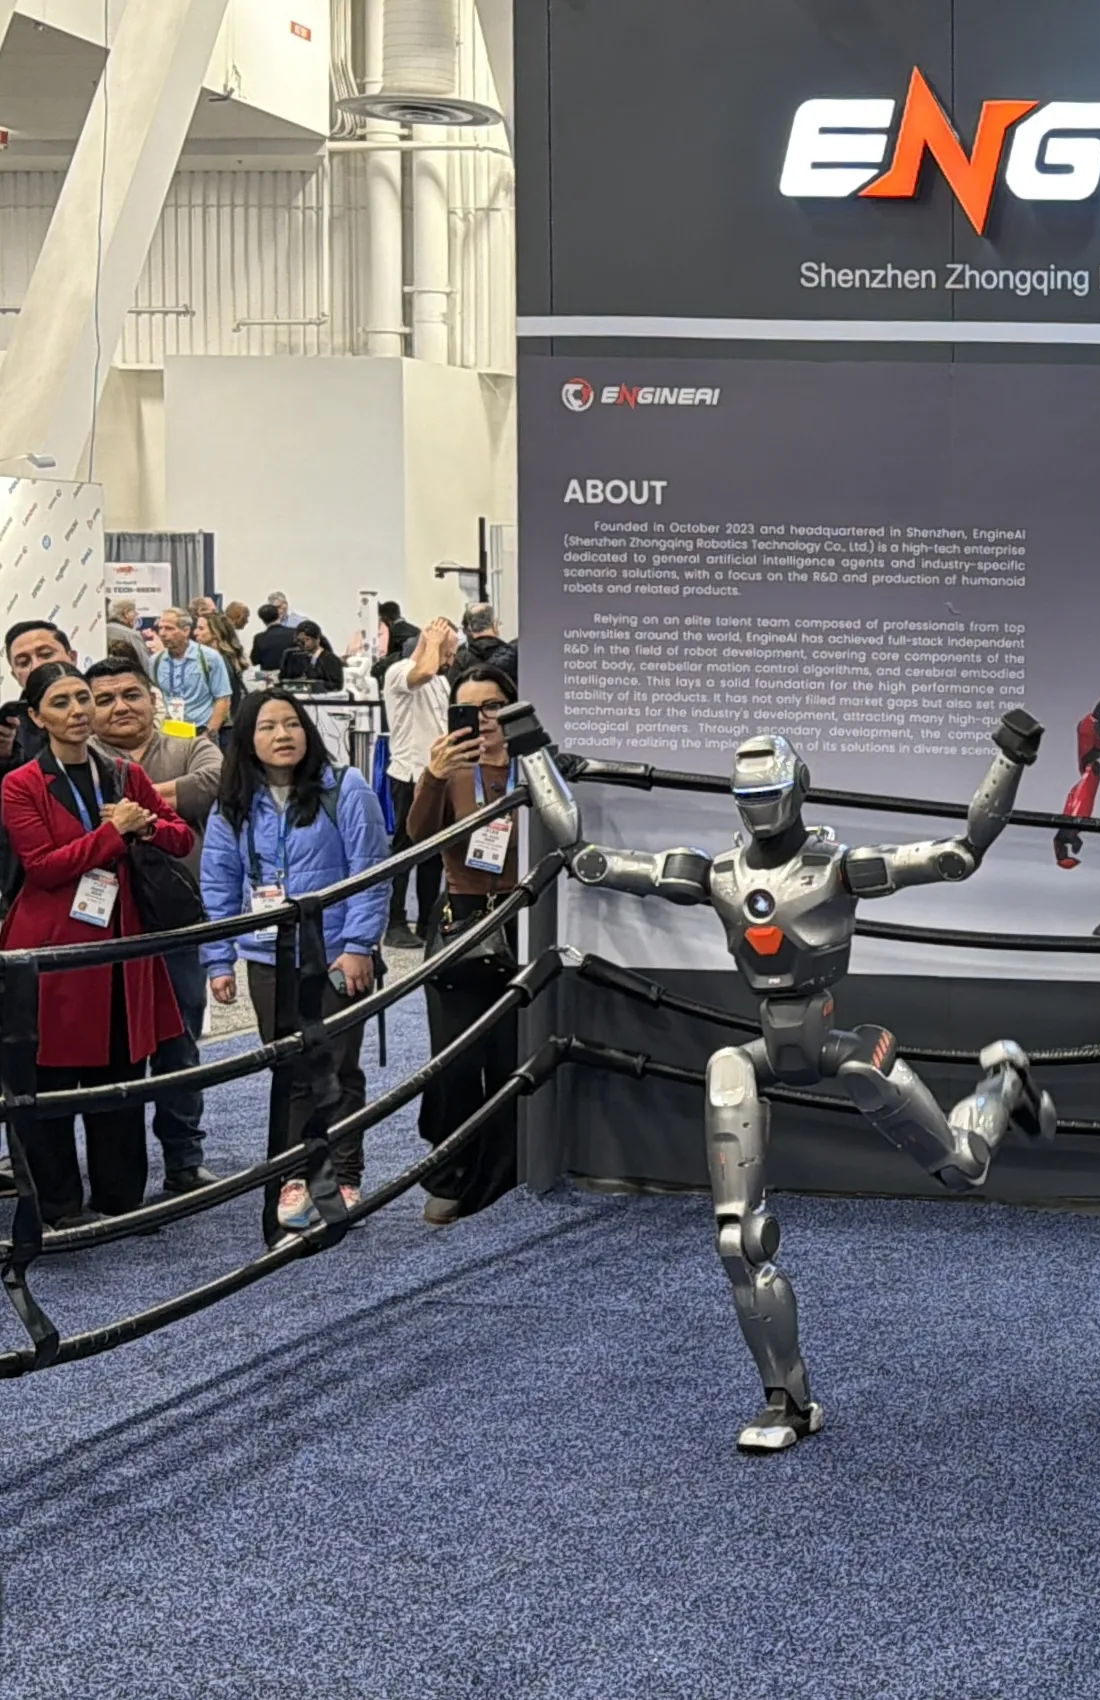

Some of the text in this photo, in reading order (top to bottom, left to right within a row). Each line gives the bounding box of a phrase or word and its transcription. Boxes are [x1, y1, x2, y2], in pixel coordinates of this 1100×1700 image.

[800, 262, 937, 289] Shenzhen
[945, 264, 1090, 296] Zhongqing
[601, 382, 720, 410] ENGINEAI
[564, 478, 668, 505] ABOUT
[594, 520, 648, 532] Founded
[653, 521, 664, 532] in
[669, 522, 720, 533] October
[726, 522, 755, 534] 2023
[760, 523, 785, 534] and
[790, 524, 884, 538] headquartered
[890, 525, 901, 536] in
[973, 527, 1026, 540] EngineAI
[564, 536, 626, 549] (Shenzhen
[630, 537, 693, 551] Zhongqing
[697, 538, 748, 549] Robotics
[752, 539, 821, 553] Technology
[878, 542, 887, 552] is
[890, 544, 899, 552] a
[902, 542, 960, 556] high-tech
[964, 543, 1025, 557] enterprise
[564, 552, 1025, 572] dedicated to general artificial intelligence agents and industry-specific
[564, 567, 617, 578] scenario
[684, 569, 709, 580] with
[715, 572, 723, 580] a
[728, 570, 762, 581] focus
[767, 572, 783, 581] on
[788, 571, 808, 582] the
[813, 571, 837, 582] R&D
[843, 572, 867, 583] and
[872, 572, 939, 586] production
[945, 574, 956, 584] of
[962, 574, 1025, 585] humanoid
[564, 582, 603, 593] robots
[607, 583, 631, 594] and
[635, 583, 679, 594] related
[594, 613, 1025, 635] Relying on an elite talent team composed of professionals from top
[564, 628, 630, 640] universities
[635, 630, 678, 641] around
[683, 630, 702, 641] the
[747, 632, 797, 645] EngineAI
[802, 632, 823, 643] has
[828, 633, 883, 644] achieved
[888, 634, 943, 645] full-stack
[948, 635, 1024, 649] independent
[564, 643, 589, 654] R&D
[594, 643, 605, 654] in
[610, 644, 630, 655] the
[635, 644, 662, 655] field
[667, 645, 679, 656] of
[684, 645, 717, 656] robot
[812, 648, 866, 661] covering
[871, 651, 899, 660] core
[904, 650, 981, 664] components
[987, 651, 999, 662] of
[1005, 652, 1025, 662] the
[564, 659, 596, 670] robot
[640, 660, 702, 672] cerebellar
[707, 662, 750, 673] motion
[755, 662, 798, 674] control
[877, 665, 900, 676] and
[905, 666, 956, 677] cerebral
[961, 667, 1024, 678] embodied
[647, 676, 670, 687] This
[676, 677, 700, 690] lays
[706, 680, 714, 688] a
[721, 678, 749, 689] solid
[756, 679, 824, 690] foundation
[831, 680, 847, 691] for
[853, 680, 873, 691] the
[879, 681, 905, 694] high
[912, 682, 994, 695] performance
[1000, 683, 1024, 694] and
[564, 690, 612, 703] stability
[618, 690, 629, 701] of
[634, 691, 648, 702] its
[714, 692, 721, 703] It
[725, 693, 747, 704] has
[752, 693, 772, 704] not
[776, 694, 802, 707] only
[806, 694, 835, 705] filled
[840, 695, 883, 706] market
[887, 698, 918, 709] gaps
[922, 696, 942, 707] but
[946, 697, 972, 708] also
[976, 697, 995, 708] set
[564, 705, 640, 717] benchmarks
[645, 706, 662, 717] for
[667, 707, 687, 718] the
[692, 708, 749, 721] industry's
[843, 710, 904, 724] attracting
[909, 714, 944, 725] many
[949, 712, 1000, 726] high-qu
[564, 721, 628, 734] ecological
[698, 724, 749, 737] Through
[756, 725, 821, 738] secondary
[920, 728, 940, 739] the
[948, 731, 992, 742] compa
[564, 736, 622, 750] gradually
[626, 737, 678, 751] realizing
[682, 738, 700, 749] the
[807, 741, 819, 752] of
[822, 741, 836, 752] its
[840, 742, 896, 753] solutions
[900, 743, 910, 753] in
[914, 743, 957, 754] diverse
[961, 746, 1000, 755] scena
